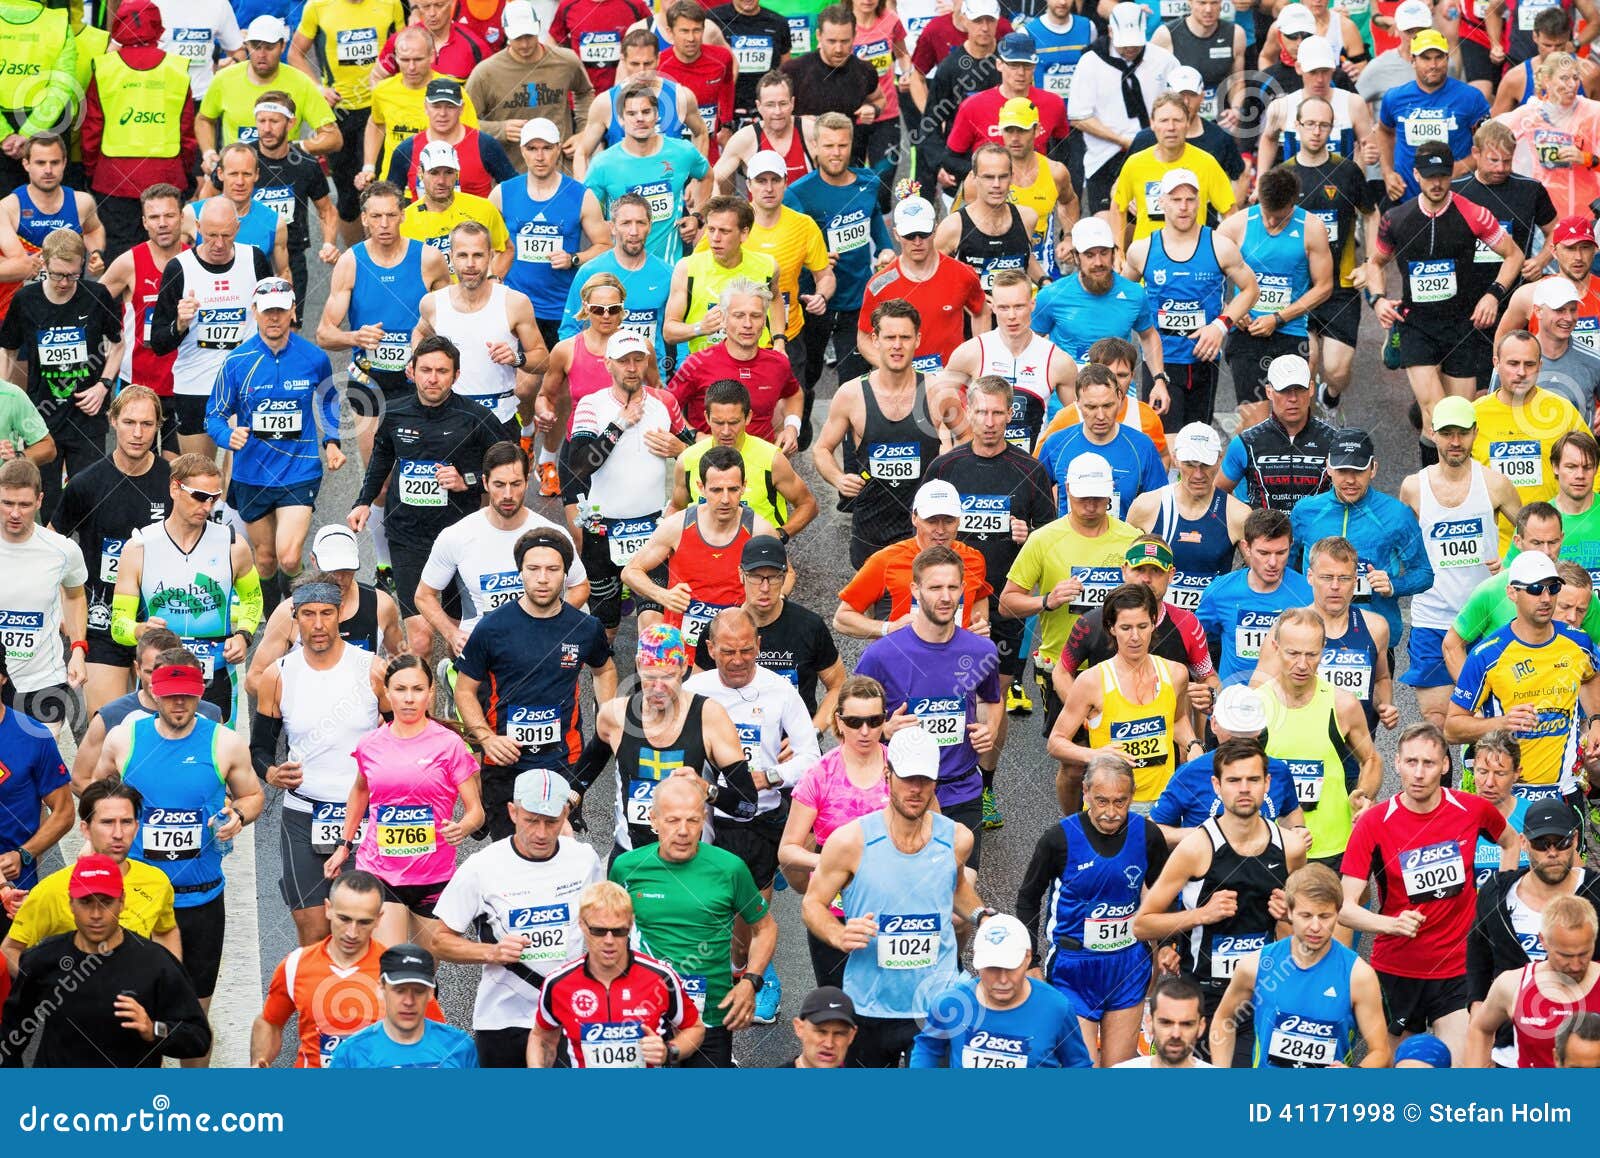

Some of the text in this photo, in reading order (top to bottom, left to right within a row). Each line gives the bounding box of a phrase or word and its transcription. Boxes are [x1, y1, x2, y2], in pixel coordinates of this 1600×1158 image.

[179, 45, 206, 56] 2330
[345, 45, 372, 57] 1049
[586, 49, 612, 60] 4427
[739, 52, 765, 64] 1158
[7, 64, 40, 75] asics
[129, 112, 165, 123] asics
[1419, 108, 1442, 118] asics
[1411, 123, 1440, 135] 4086
[264, 189, 288, 199] asics
[641, 186, 665, 196] asics
[841, 212, 864, 224] asics
[29, 220, 64, 228] saucony
[533, 224, 557, 234] asics
[835, 226, 865, 240] 1509
[523, 240, 554, 253] 1871
[1001, 258, 1020, 268] asics
[1423, 263, 1449, 272] asics
[1262, 277, 1286, 286] asics
[1416, 278, 1448, 292] 3292
[1173, 300, 1198, 310] asics
[216, 311, 241, 320] asics
[628, 310, 652, 321] asics
[1165, 315, 1198, 328] 2291
[1576, 320, 1595, 330] sics
[54, 332, 80, 341] asics
[205, 327, 239, 340] 1077
[45, 347, 78, 361] 2951
[269, 399, 296, 410] asics
[259, 415, 293, 430] 1781
[1004, 428, 1024, 439] sics
[889, 445, 914, 455] asics
[1505, 444, 1533, 454] asics
[1257, 455, 1325, 465] GSG
[876, 462, 912, 477] 2568
[1497, 461, 1534, 476] 1098
[1263, 476, 1319, 485] TEAM LINE
[404, 481, 439, 495] 2202
[974, 498, 1006, 509] asics
[964, 515, 1001, 529] 2245
[622, 525, 652, 536] asics
[1449, 523, 1477, 534] asics
[1440, 541, 1477, 556] 1040
[1090, 571, 1118, 581] asics
[1183, 575, 1211, 586] asics
[153, 578, 221, 596] Asphalt
[168, 594, 223, 610] Green
[169, 604, 223, 613] TRIATHLON
[8, 614, 39, 625] asics
[1334, 653, 1364, 664] asics
[1324, 671, 1363, 688] 1683
[929, 701, 959, 712] asics
[526, 709, 555, 720] asics
[1132, 721, 1160, 733] asics
[515, 726, 554, 742] 3019
[1527, 790, 1557, 800] asics
[164, 814, 196, 824] asics
[394, 810, 432, 821] asics
[153, 832, 193, 847] 1764
[385, 828, 427, 845] 3766
[1420, 847, 1451, 860] asics
[1413, 866, 1455, 891] 3020
[530, 909, 562, 921] asics
[1103, 904, 1134, 916] asics
[901, 919, 933, 930] asics
[1098, 924, 1128, 940] 514
[888, 939, 929, 956] 1024
[1233, 937, 1265, 950] asics
[603, 1027, 639, 1039] asics
[1297, 1021, 1332, 1036] asics
[986, 1039, 1020, 1052] asics
[1279, 1038, 1325, 1060] 2849
[590, 1047, 636, 1065] 1048
